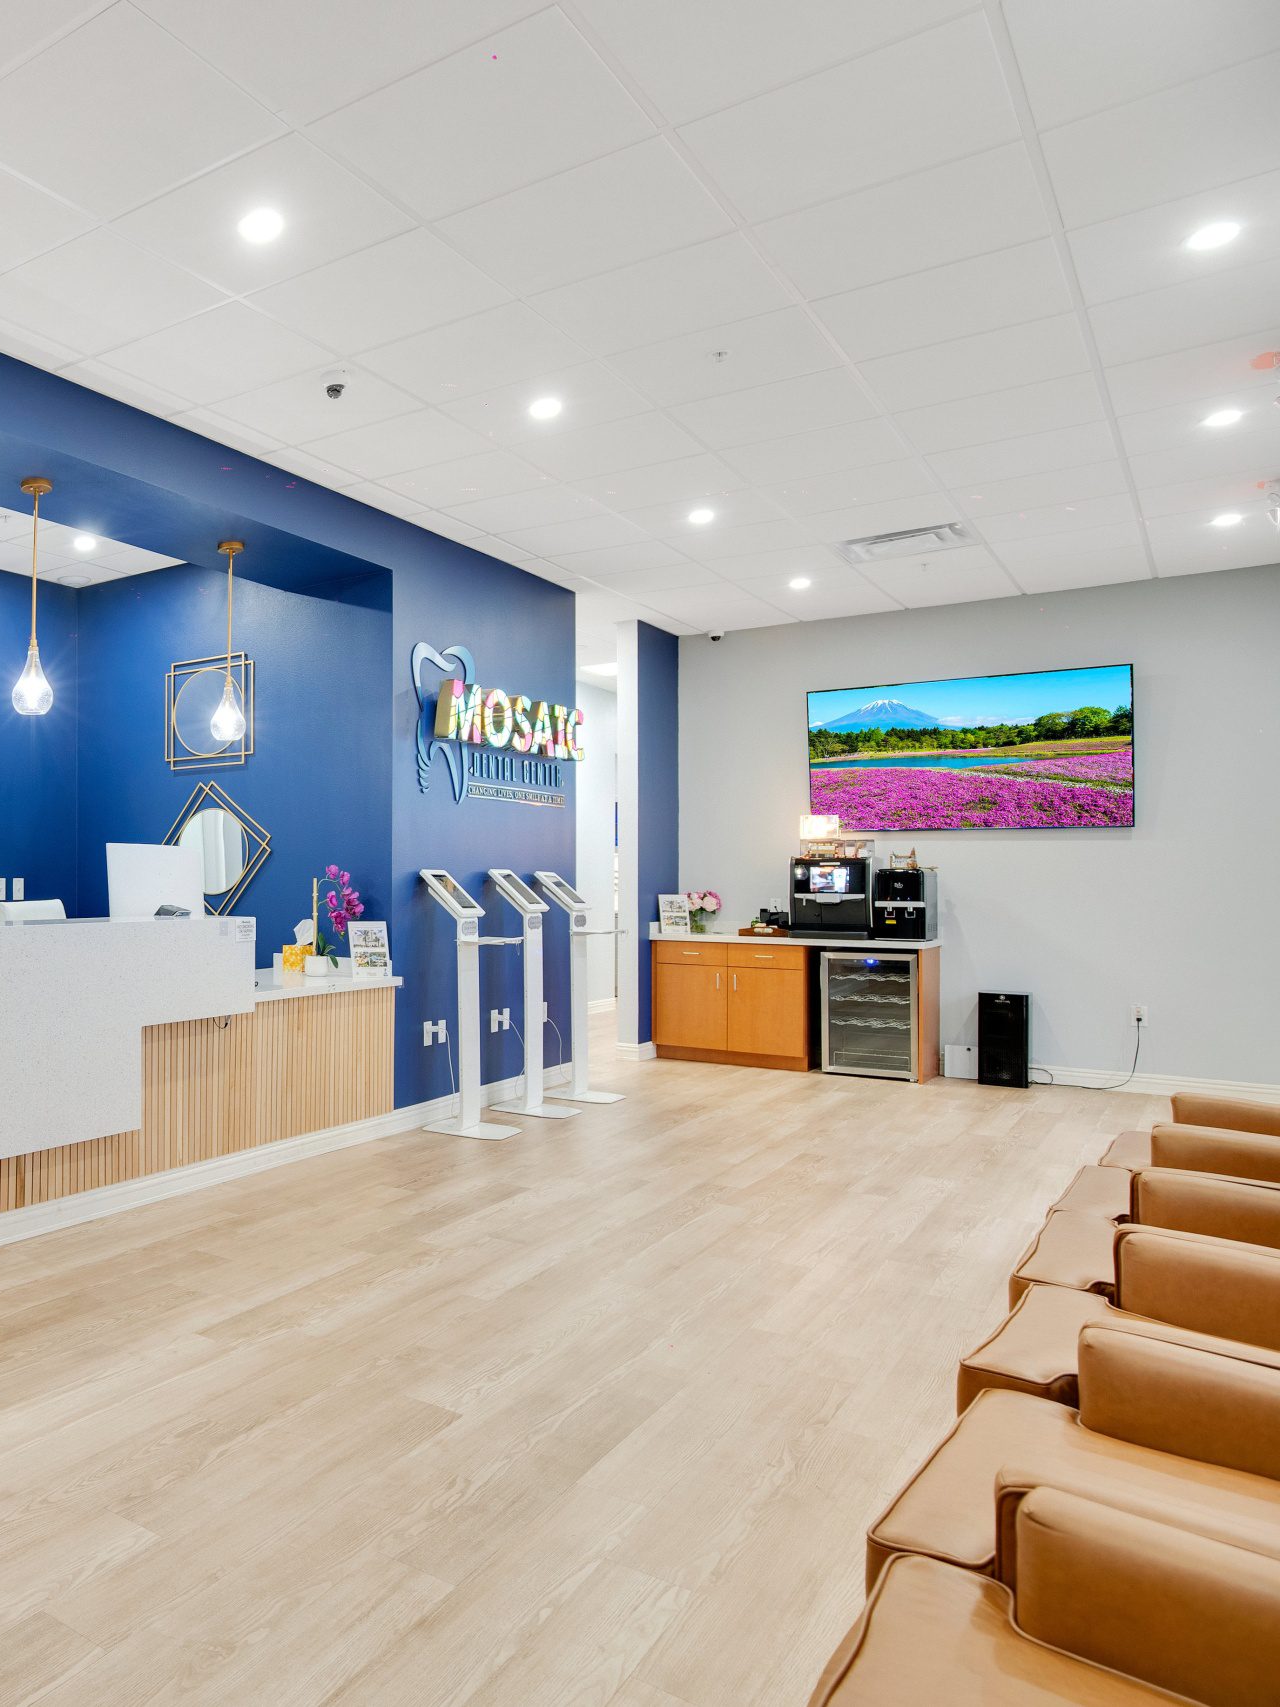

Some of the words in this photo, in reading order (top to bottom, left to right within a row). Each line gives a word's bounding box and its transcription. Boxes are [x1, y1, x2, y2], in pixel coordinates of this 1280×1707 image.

[435, 679, 585, 761] MOSAIC
[472, 752, 517, 782] DENTAL
[522, 760, 562, 788] CENTER
[468, 785, 497, 797] CHANGING
[514, 790, 526, 800] ONE
[526, 792, 540, 801] SMILE
